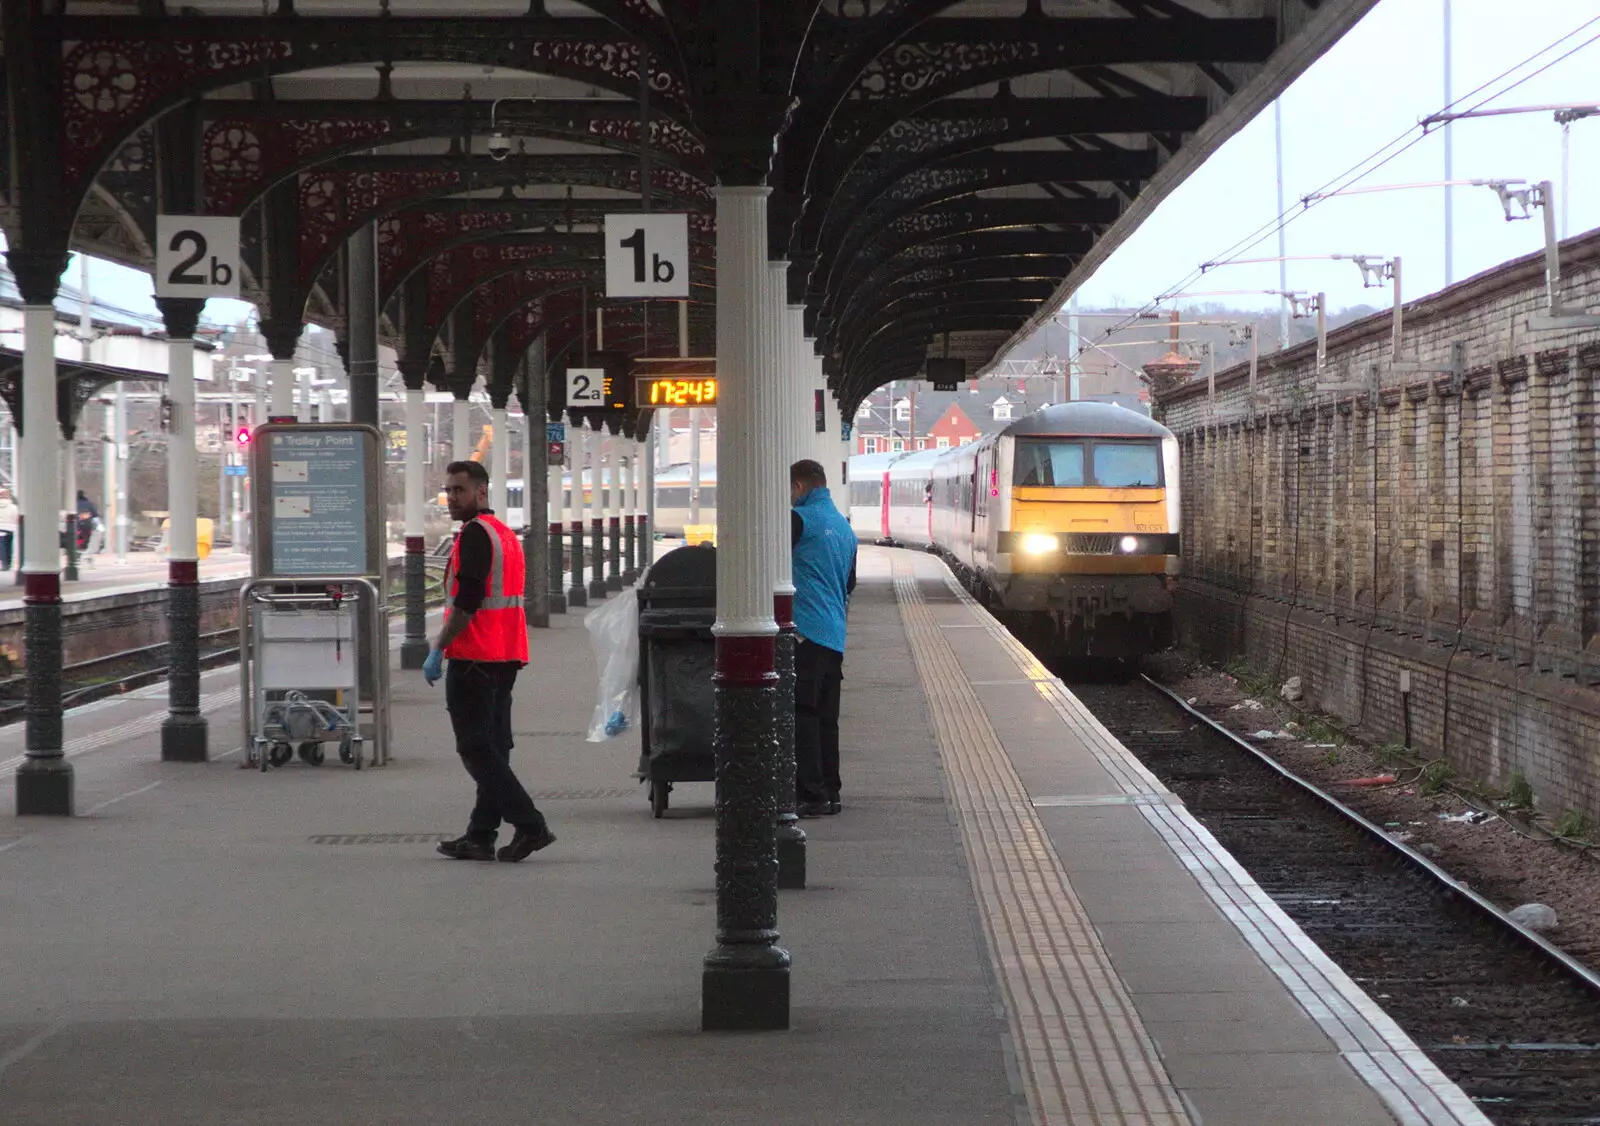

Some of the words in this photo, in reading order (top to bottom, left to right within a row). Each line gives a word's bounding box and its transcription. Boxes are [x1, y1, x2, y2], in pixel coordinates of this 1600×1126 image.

[168, 230, 232, 286] 2b
[620, 228, 675, 283] 1b
[572, 375, 600, 400] 2a
[285, 435, 321, 446] Trolley
[325, 435, 354, 445] Point
